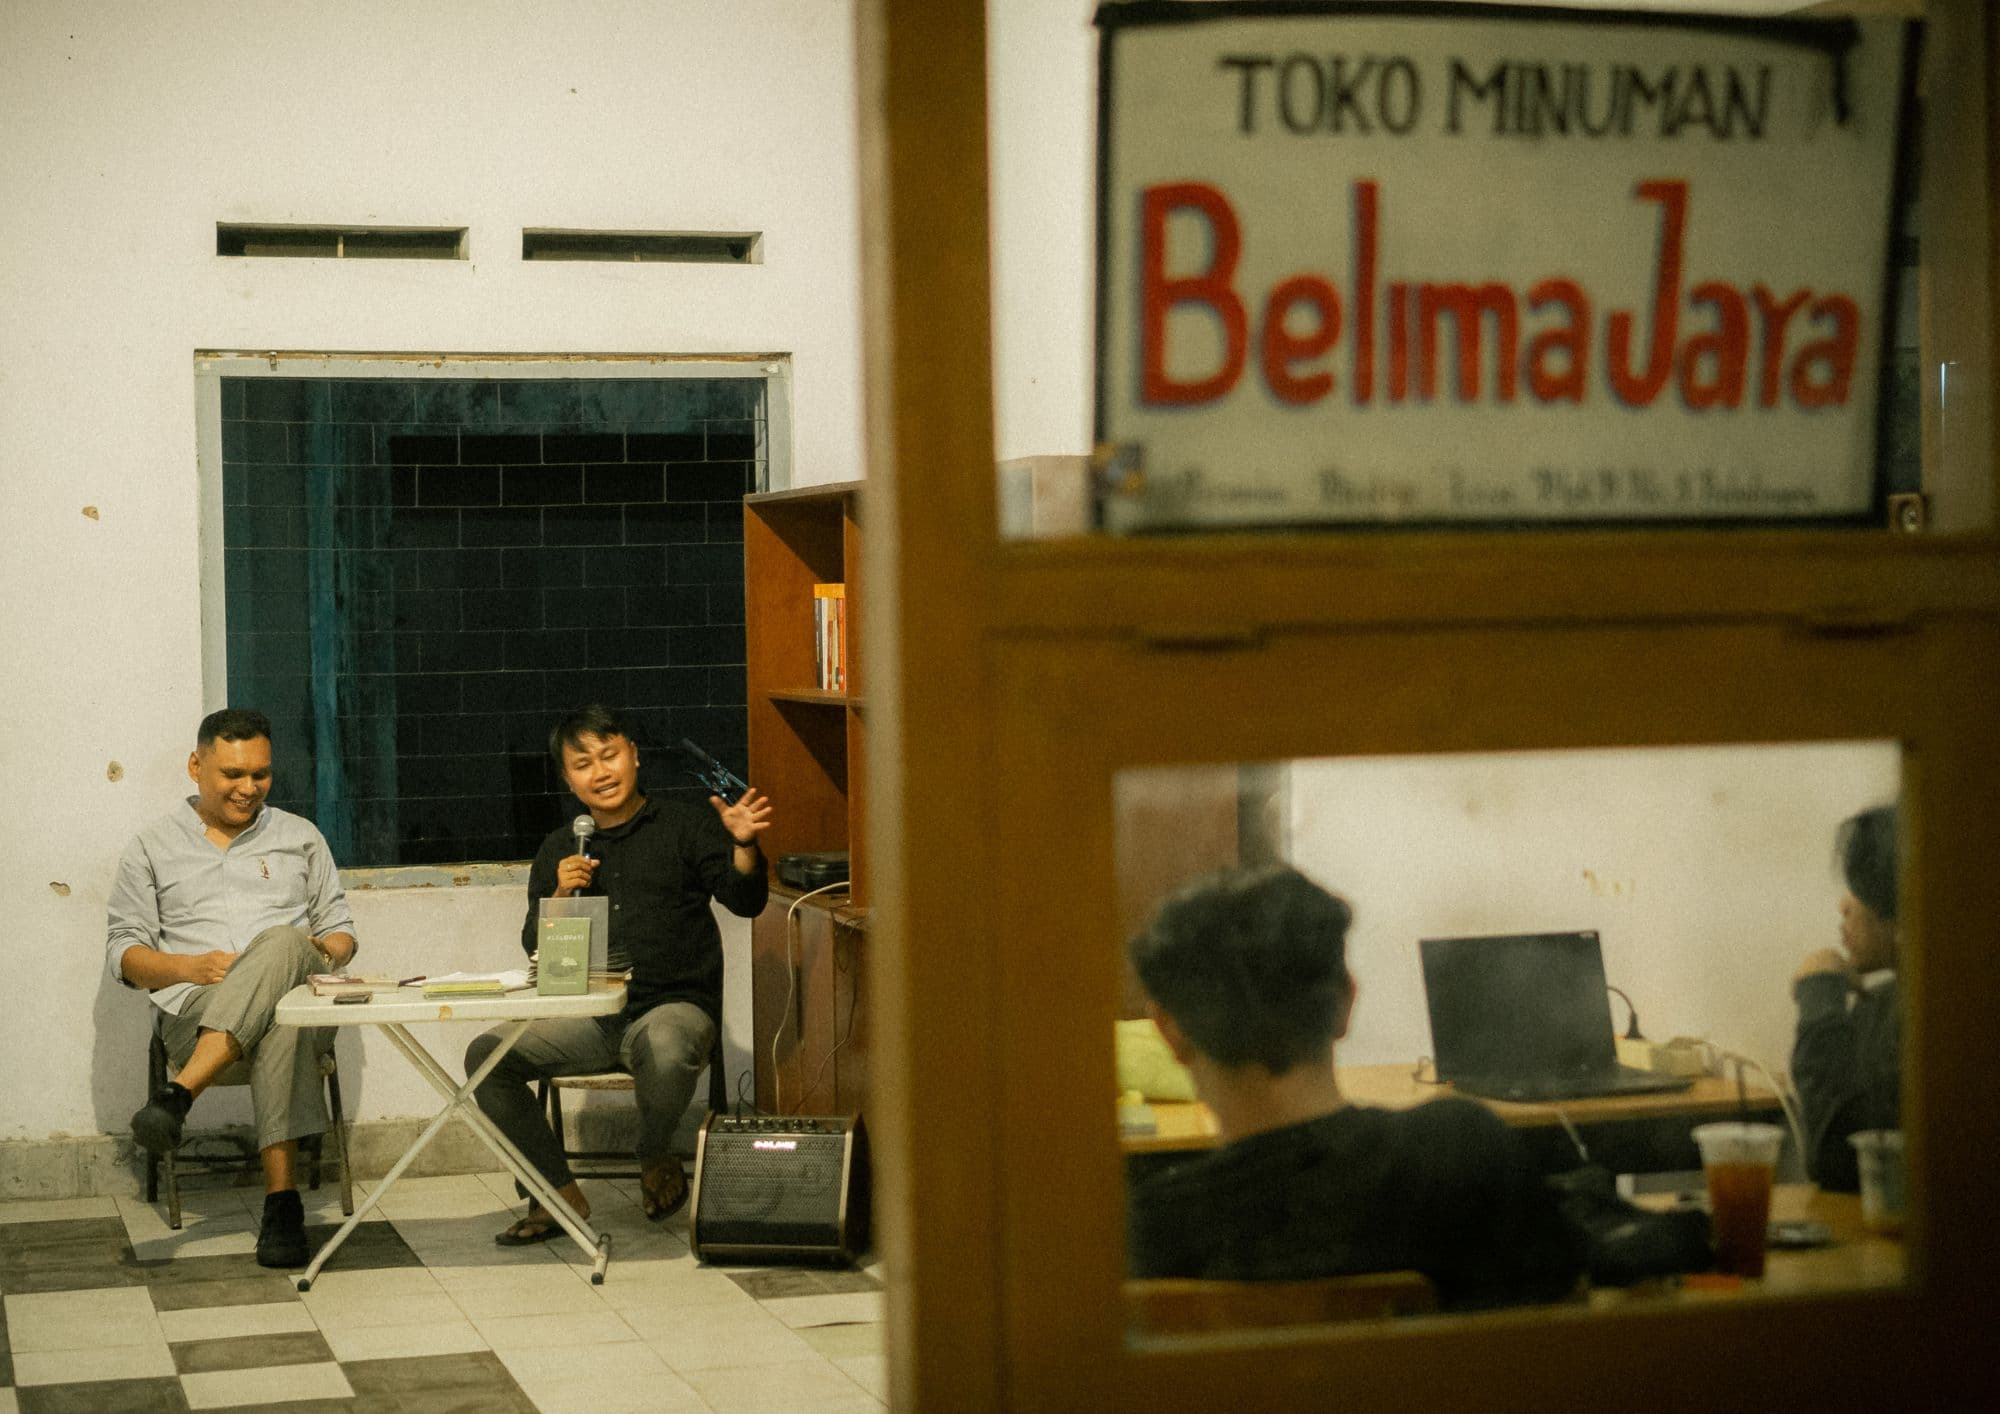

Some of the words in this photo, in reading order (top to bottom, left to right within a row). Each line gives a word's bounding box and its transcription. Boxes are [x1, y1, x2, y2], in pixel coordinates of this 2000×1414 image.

[1219, 53, 1421, 138] TOKO
[1447, 60, 1772, 140] MINUMAN
[1608, 179, 1862, 409] Jaya
